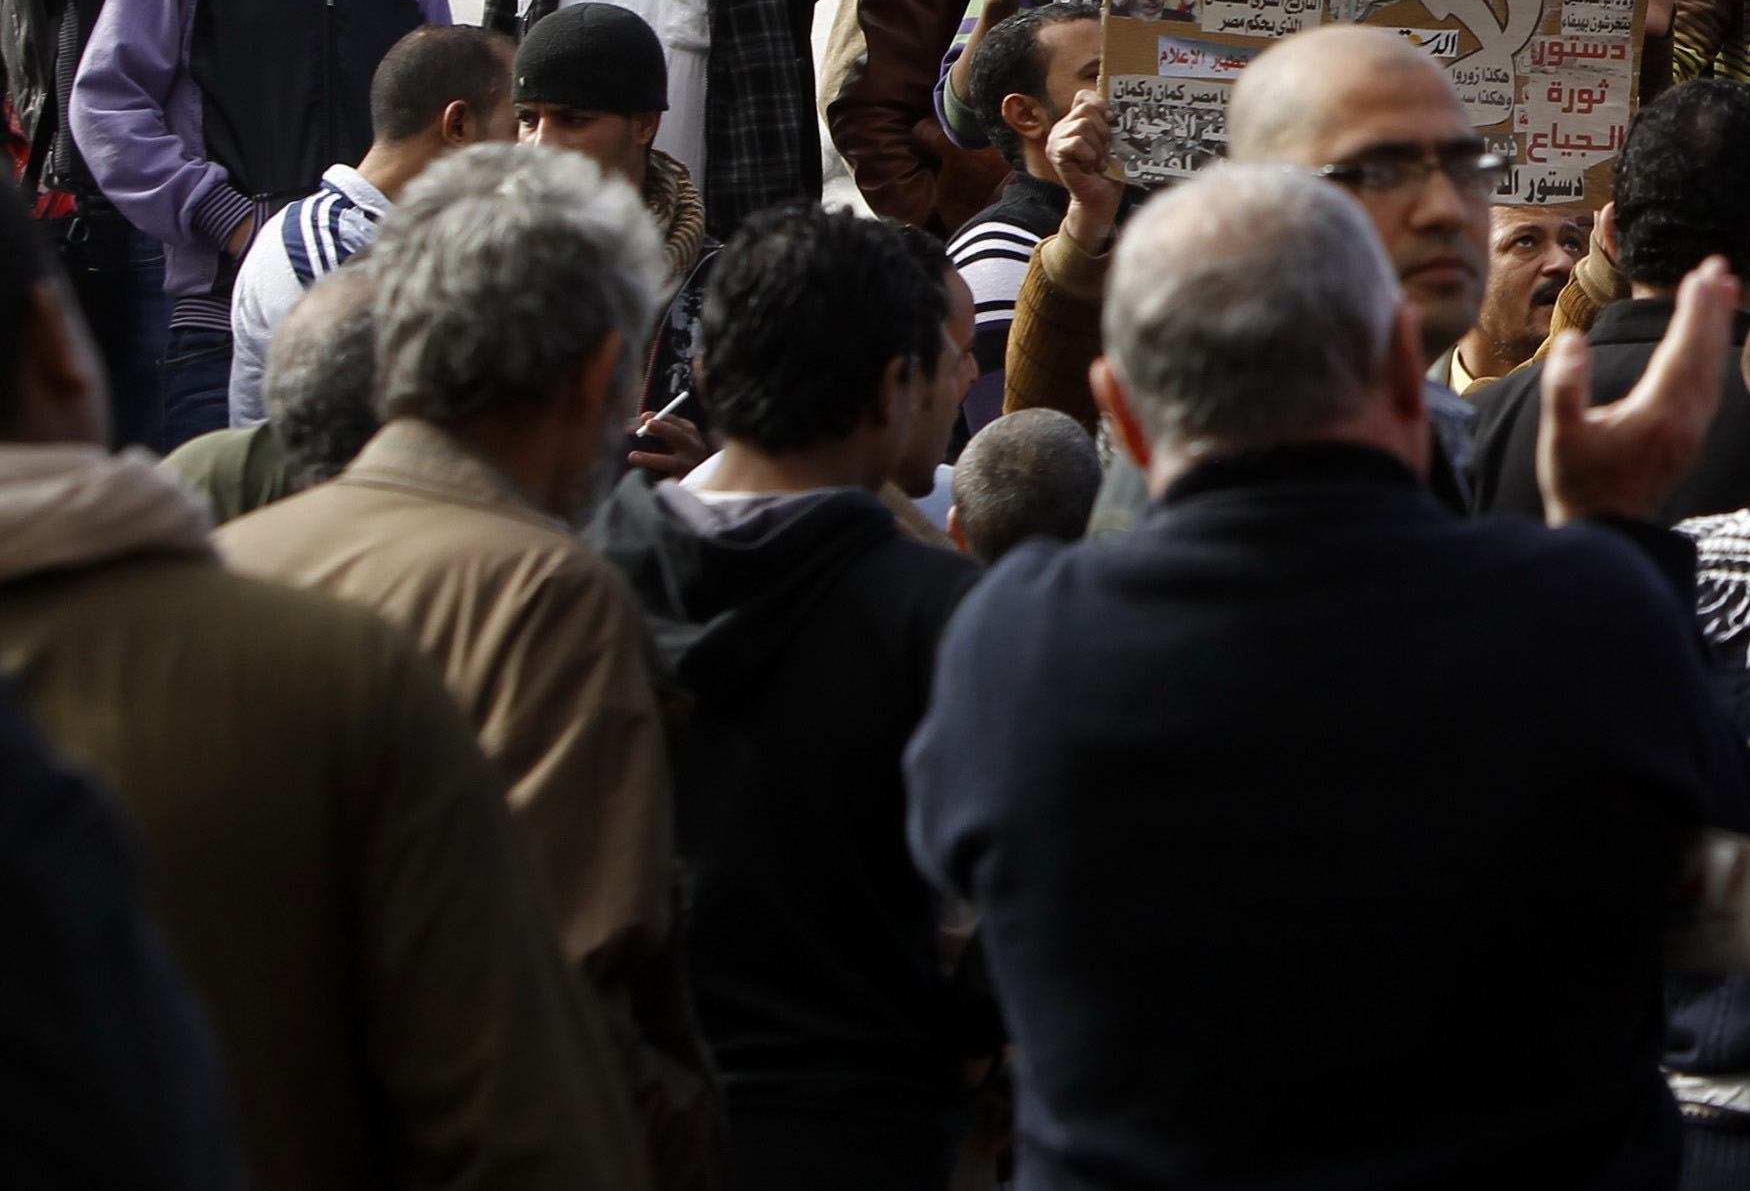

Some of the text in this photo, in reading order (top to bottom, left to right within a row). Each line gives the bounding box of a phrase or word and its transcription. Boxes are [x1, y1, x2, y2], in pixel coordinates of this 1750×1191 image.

[1219, 16, 1245, 31] مصر
[1532, 36, 1626, 67] دستور
[1114, 80, 1153, 102] وكمان
[1153, 84, 1185, 103] كمان
[1187, 92, 1218, 105] مصر
[1547, 78, 1609, 114] ثورة
[1526, 122, 1627, 163] الجياع
[1524, 170, 1584, 203] دستور
